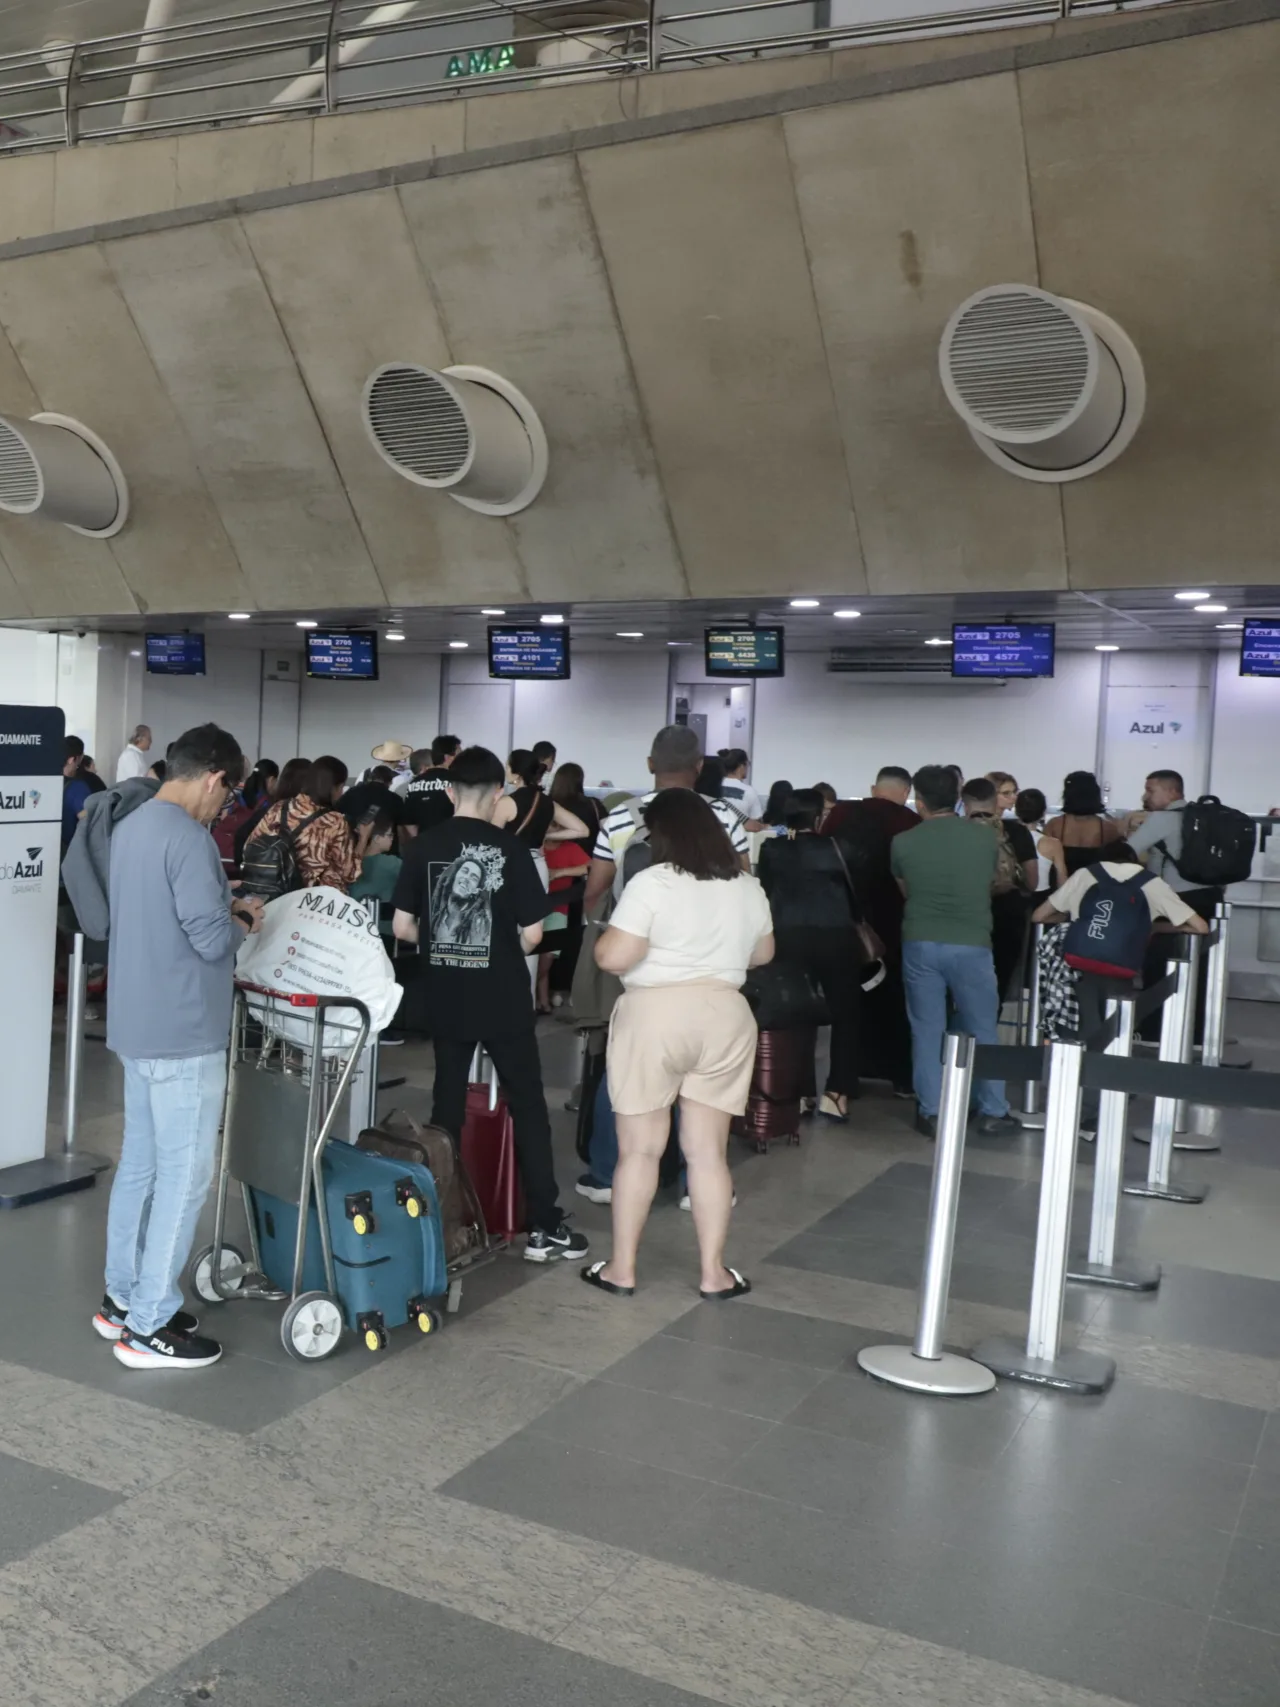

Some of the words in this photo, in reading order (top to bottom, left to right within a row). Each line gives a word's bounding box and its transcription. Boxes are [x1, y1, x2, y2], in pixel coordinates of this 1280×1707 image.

[1129, 721, 1165, 734] Azul
[1087, 900, 1114, 939] FILA
[460, 960, 489, 968] LEGEND
[149, 1337, 175, 1356] FILA
